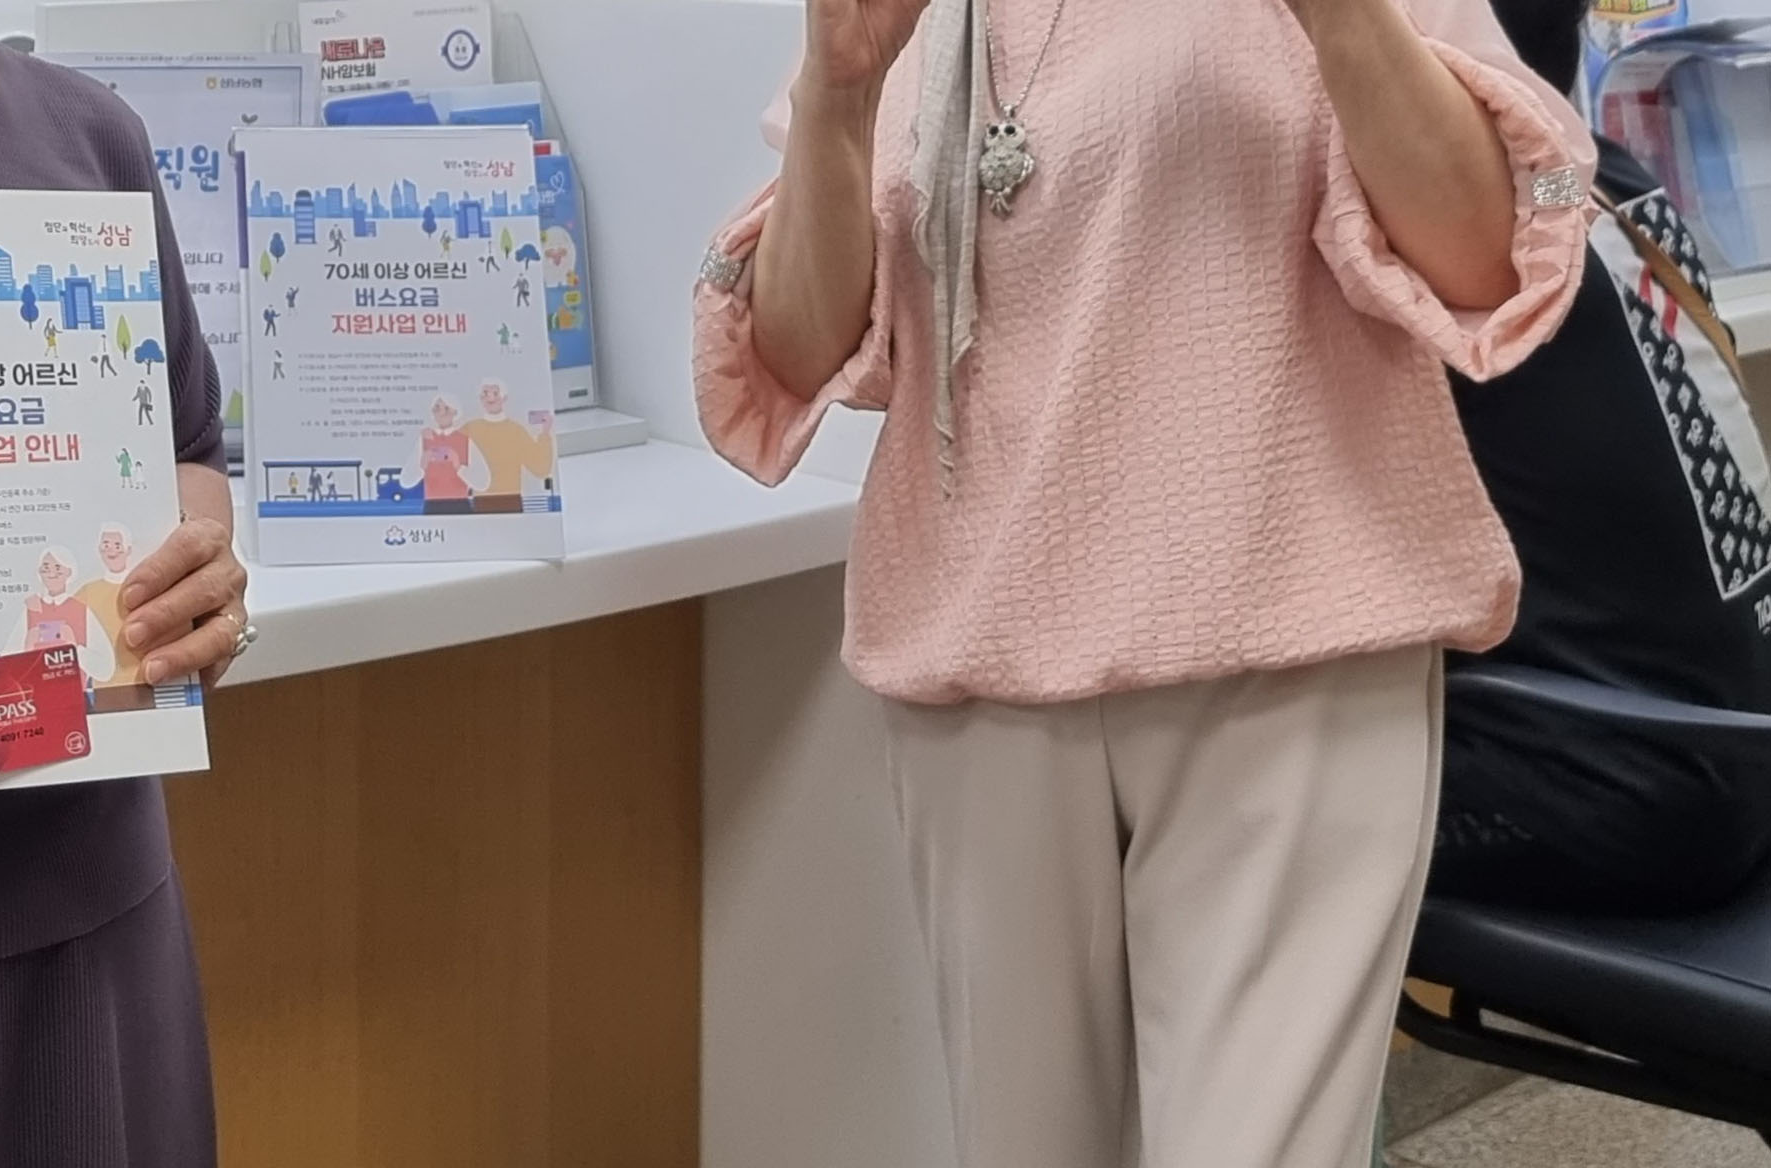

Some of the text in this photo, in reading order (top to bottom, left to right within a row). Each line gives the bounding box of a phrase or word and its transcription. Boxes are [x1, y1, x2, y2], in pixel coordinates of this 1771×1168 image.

[486, 159, 516, 178] 성남
[97, 221, 133, 247] 성남
[324, 261, 468, 281] 70세 이상 어르신
[354, 286, 440, 308] 버스요금
[331, 313, 468, 335] 지원사업 안내
[12, 362, 79, 388] 어르신
[24, 433, 81, 464] 안내
[407, 526, 446, 544] 성남시
[44, 648, 75, 667] NH
